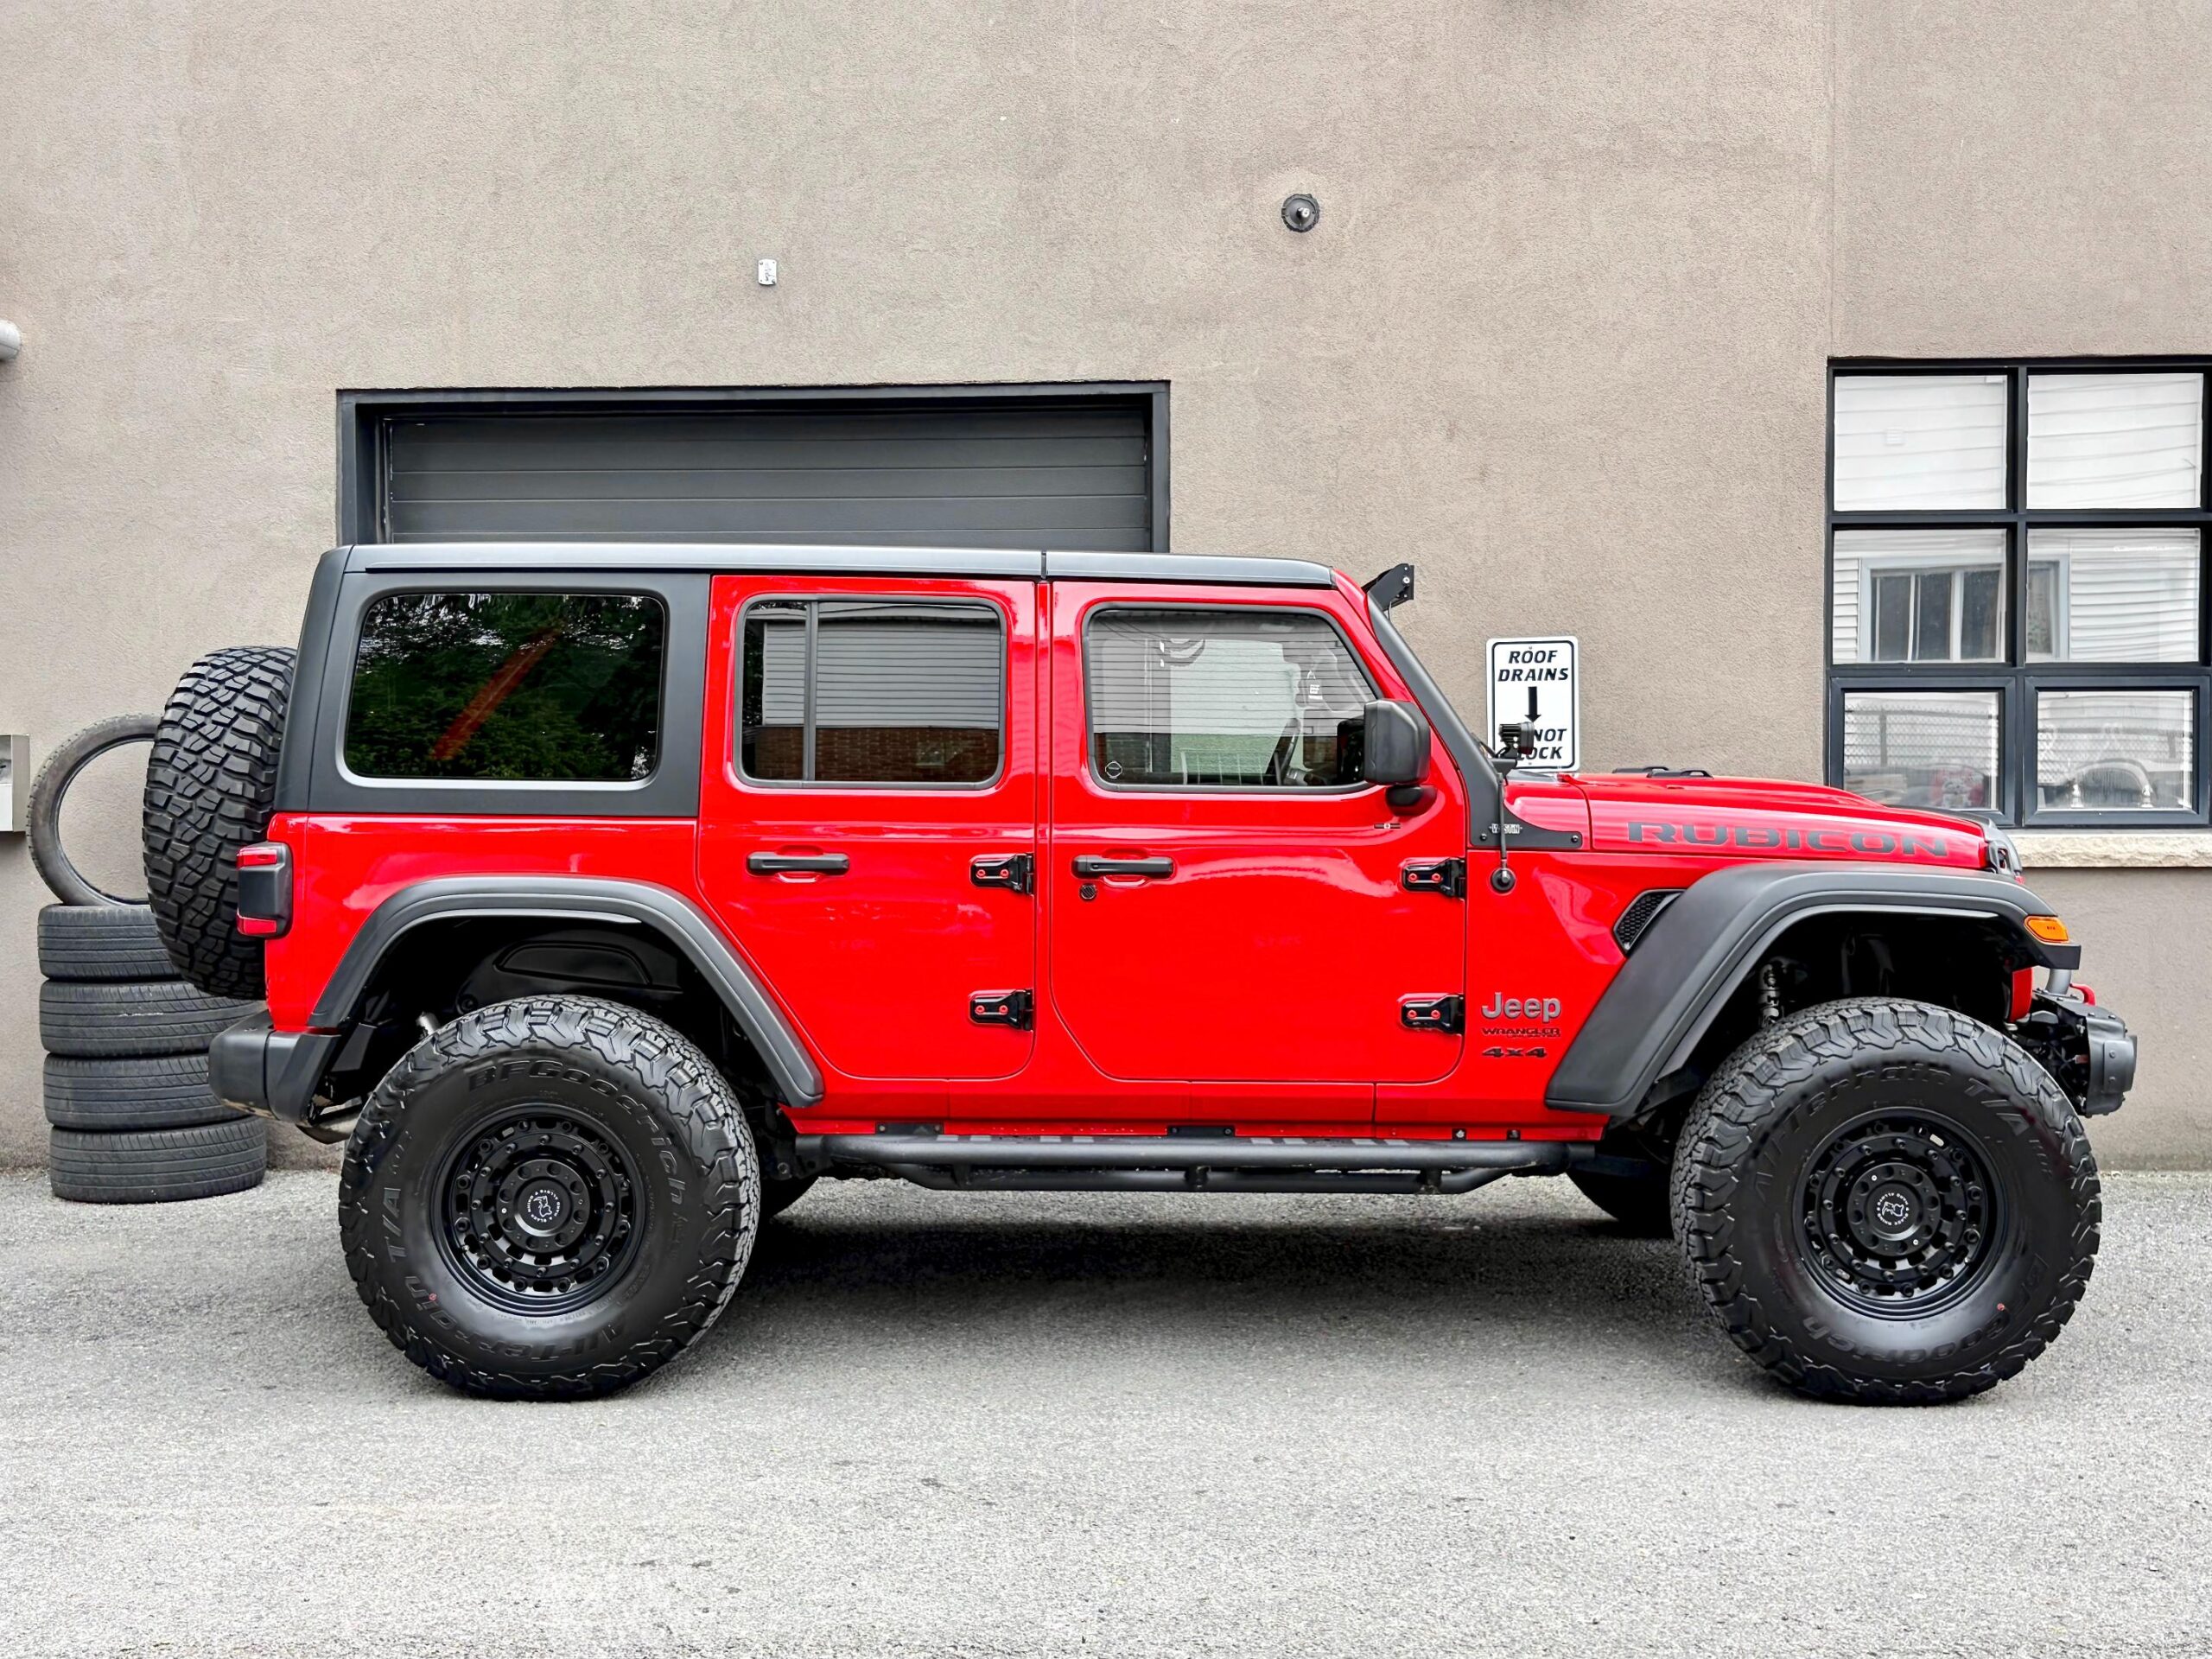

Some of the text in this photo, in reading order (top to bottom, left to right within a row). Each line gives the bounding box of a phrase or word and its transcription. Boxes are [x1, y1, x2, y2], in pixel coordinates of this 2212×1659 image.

[1508, 650, 1558, 664] ROOF
[1497, 668, 1569, 682] DRAINS
[1627, 822, 1948, 856] RUBICON
[1482, 992, 1561, 1023] Jeep
[1481, 1027, 1560, 1036] WRANGLER
